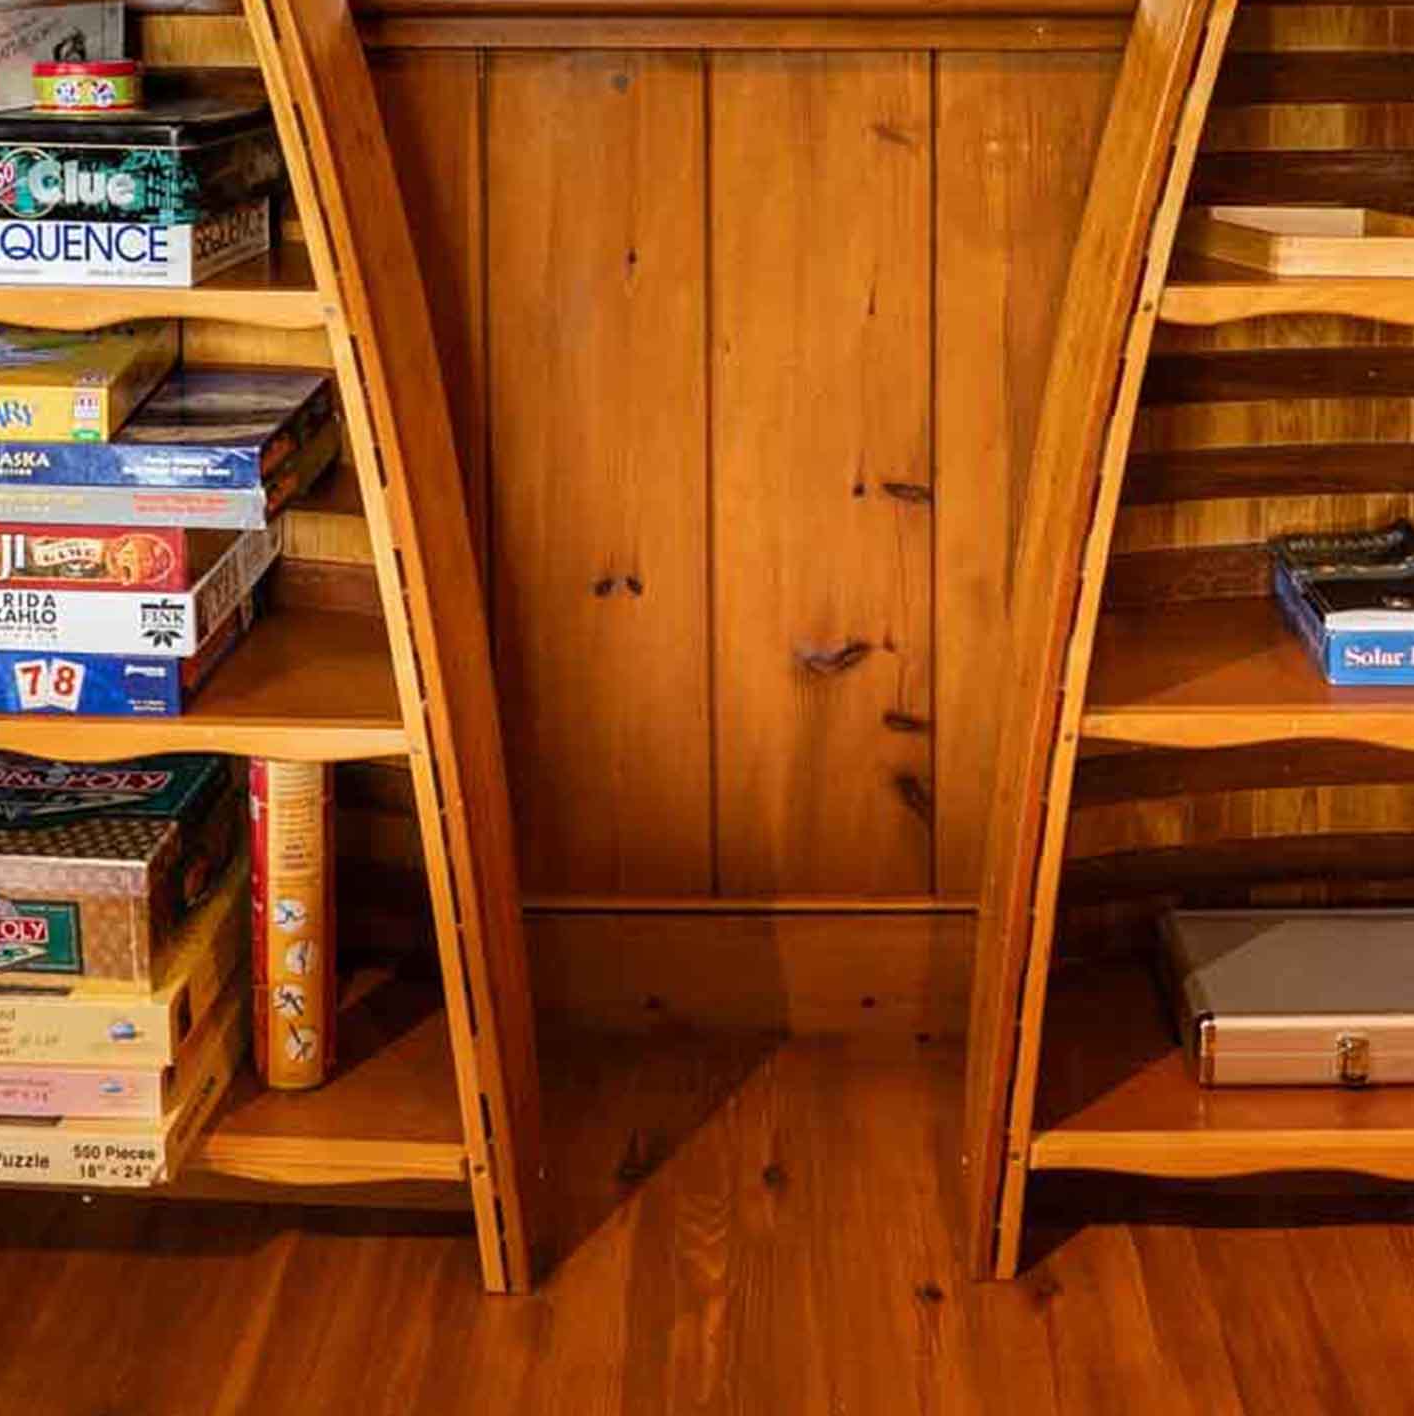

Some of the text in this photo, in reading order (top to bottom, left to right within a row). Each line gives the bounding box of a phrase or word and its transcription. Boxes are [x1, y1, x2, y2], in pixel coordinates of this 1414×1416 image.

[27, 159, 139, 204] Clue
[141, 610, 185, 625] FINK
[1344, 644, 1404, 667] Solar
[20, 665, 42, 696] 7
[53, 665, 76, 696] 8
[105, 1146, 155, 1160] Pieces
